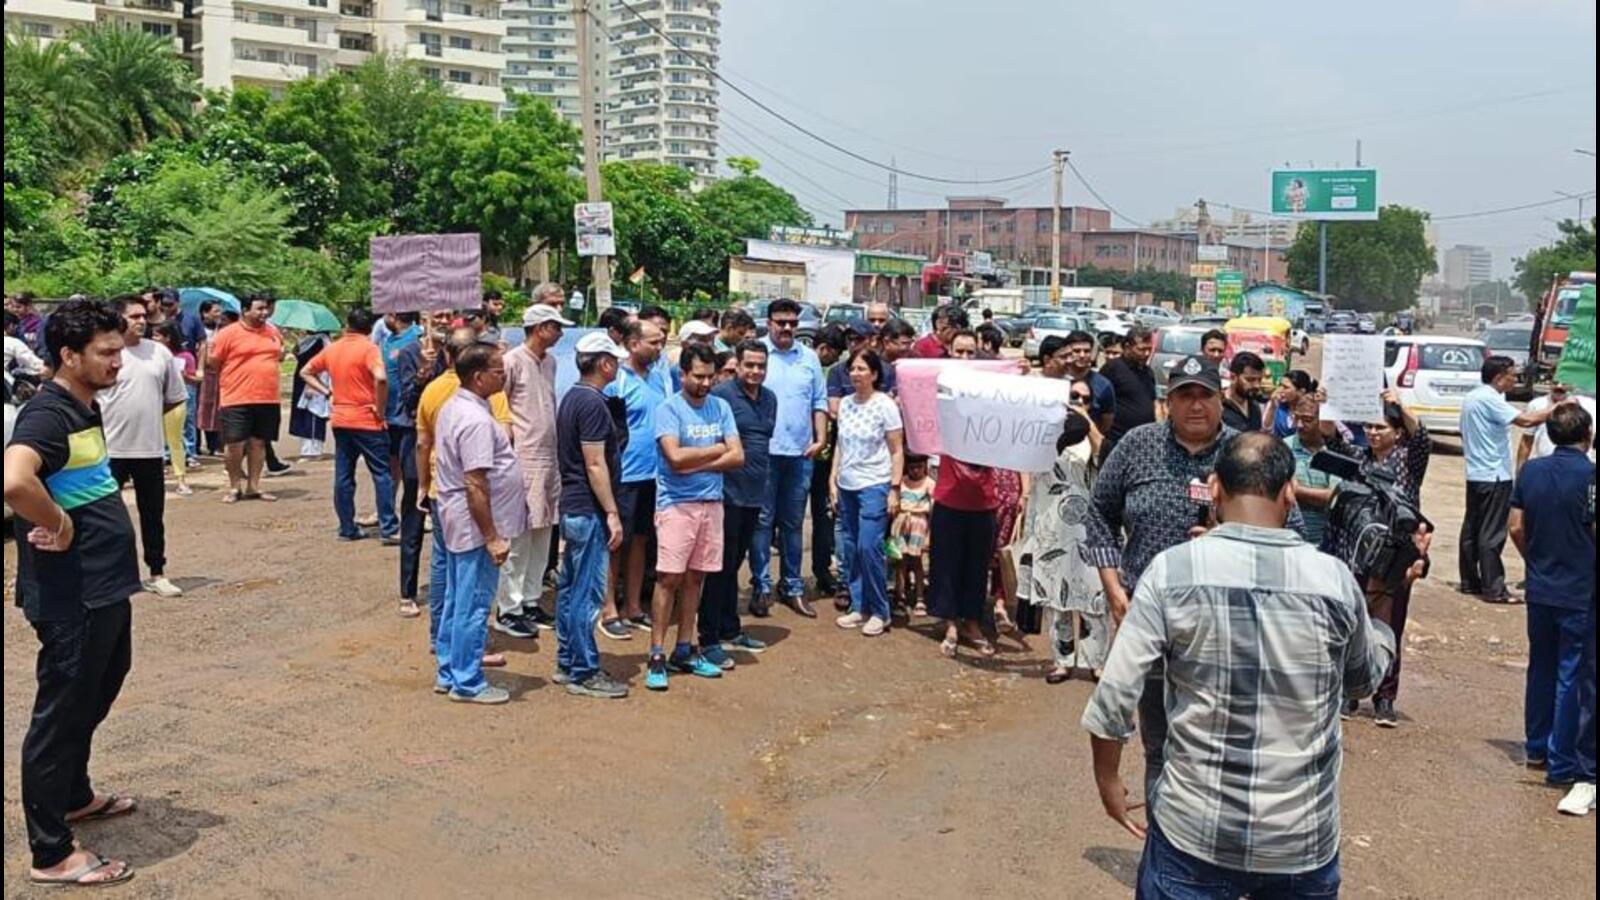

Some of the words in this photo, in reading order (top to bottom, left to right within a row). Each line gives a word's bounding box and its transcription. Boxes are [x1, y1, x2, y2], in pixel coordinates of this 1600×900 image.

[687, 424, 723, 440] REBEL
[963, 415, 1002, 446] NO
[1012, 418, 1059, 446] VOTE
